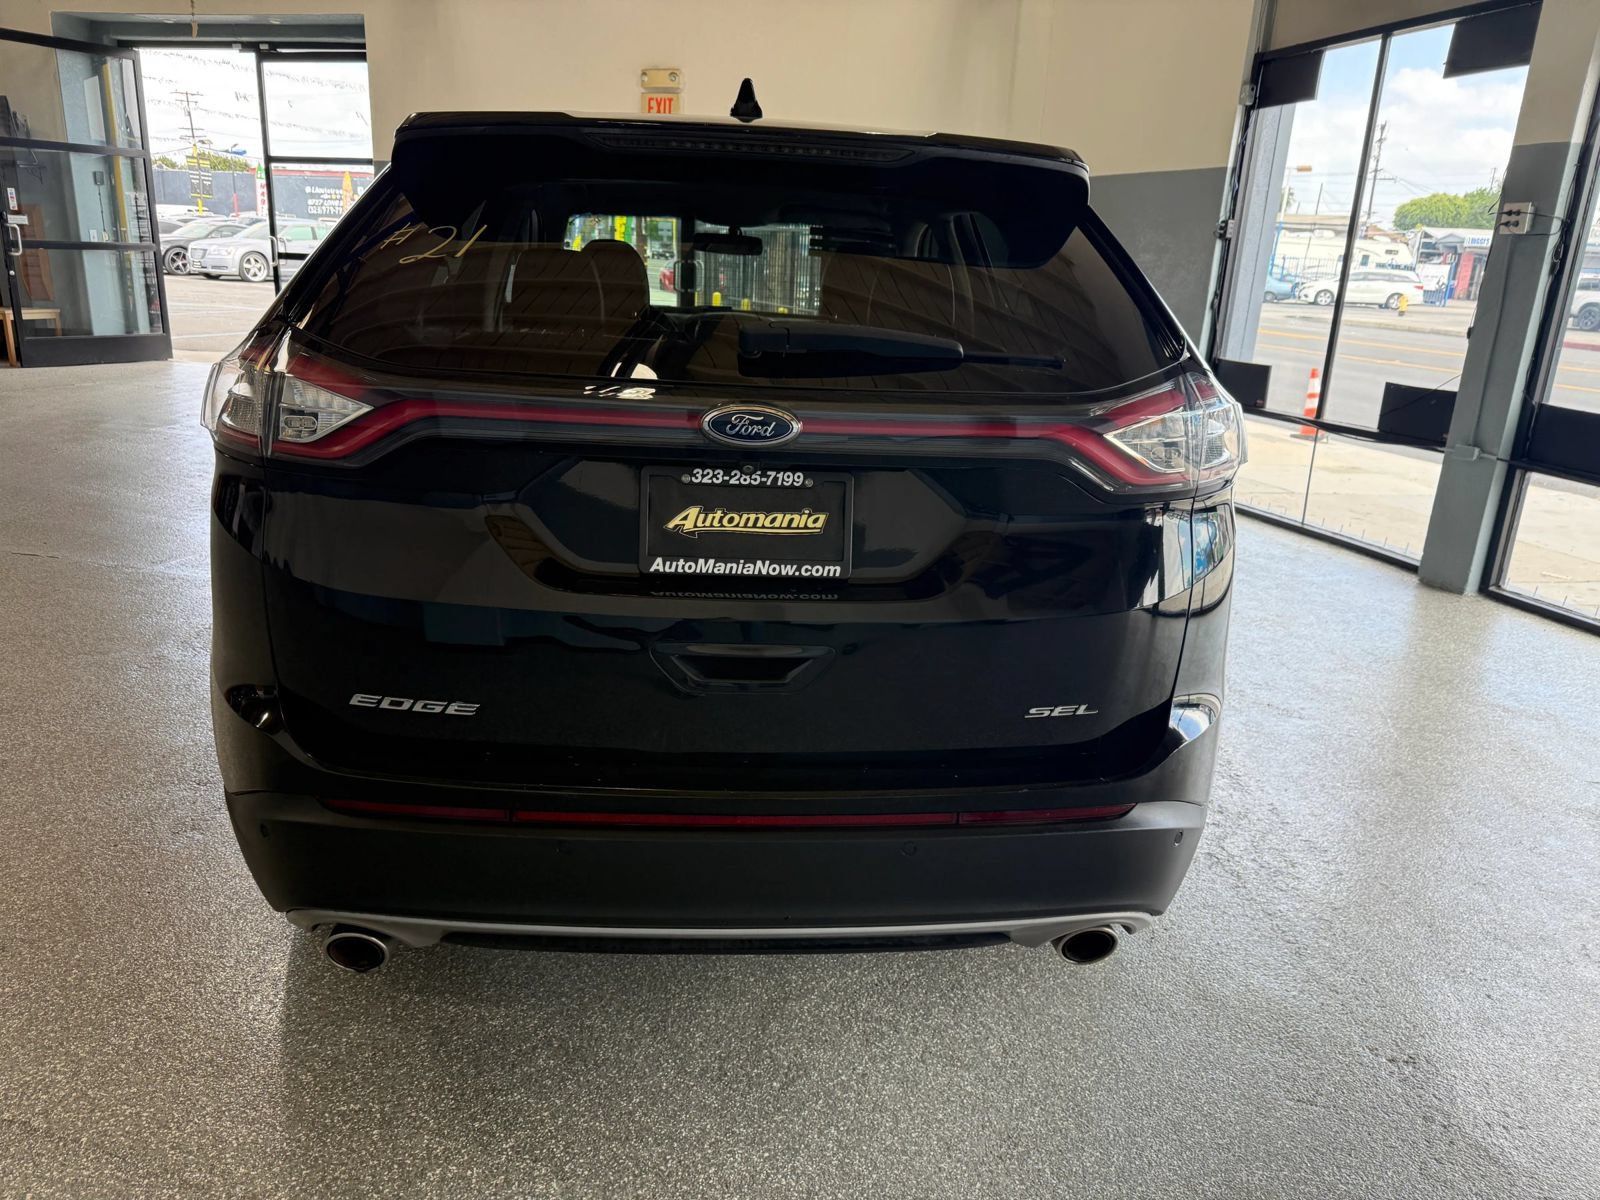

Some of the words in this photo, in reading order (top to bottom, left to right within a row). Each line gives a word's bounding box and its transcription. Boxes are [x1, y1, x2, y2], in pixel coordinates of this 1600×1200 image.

[647, 96, 673, 114] EXIT
[725, 414, 776, 437] Ford
[664, 506, 829, 538] Automania
[650, 557, 841, 577] AutoManiaNow.com
[349, 694, 480, 716] EDGE
[1024, 703, 1099, 719] SEL
